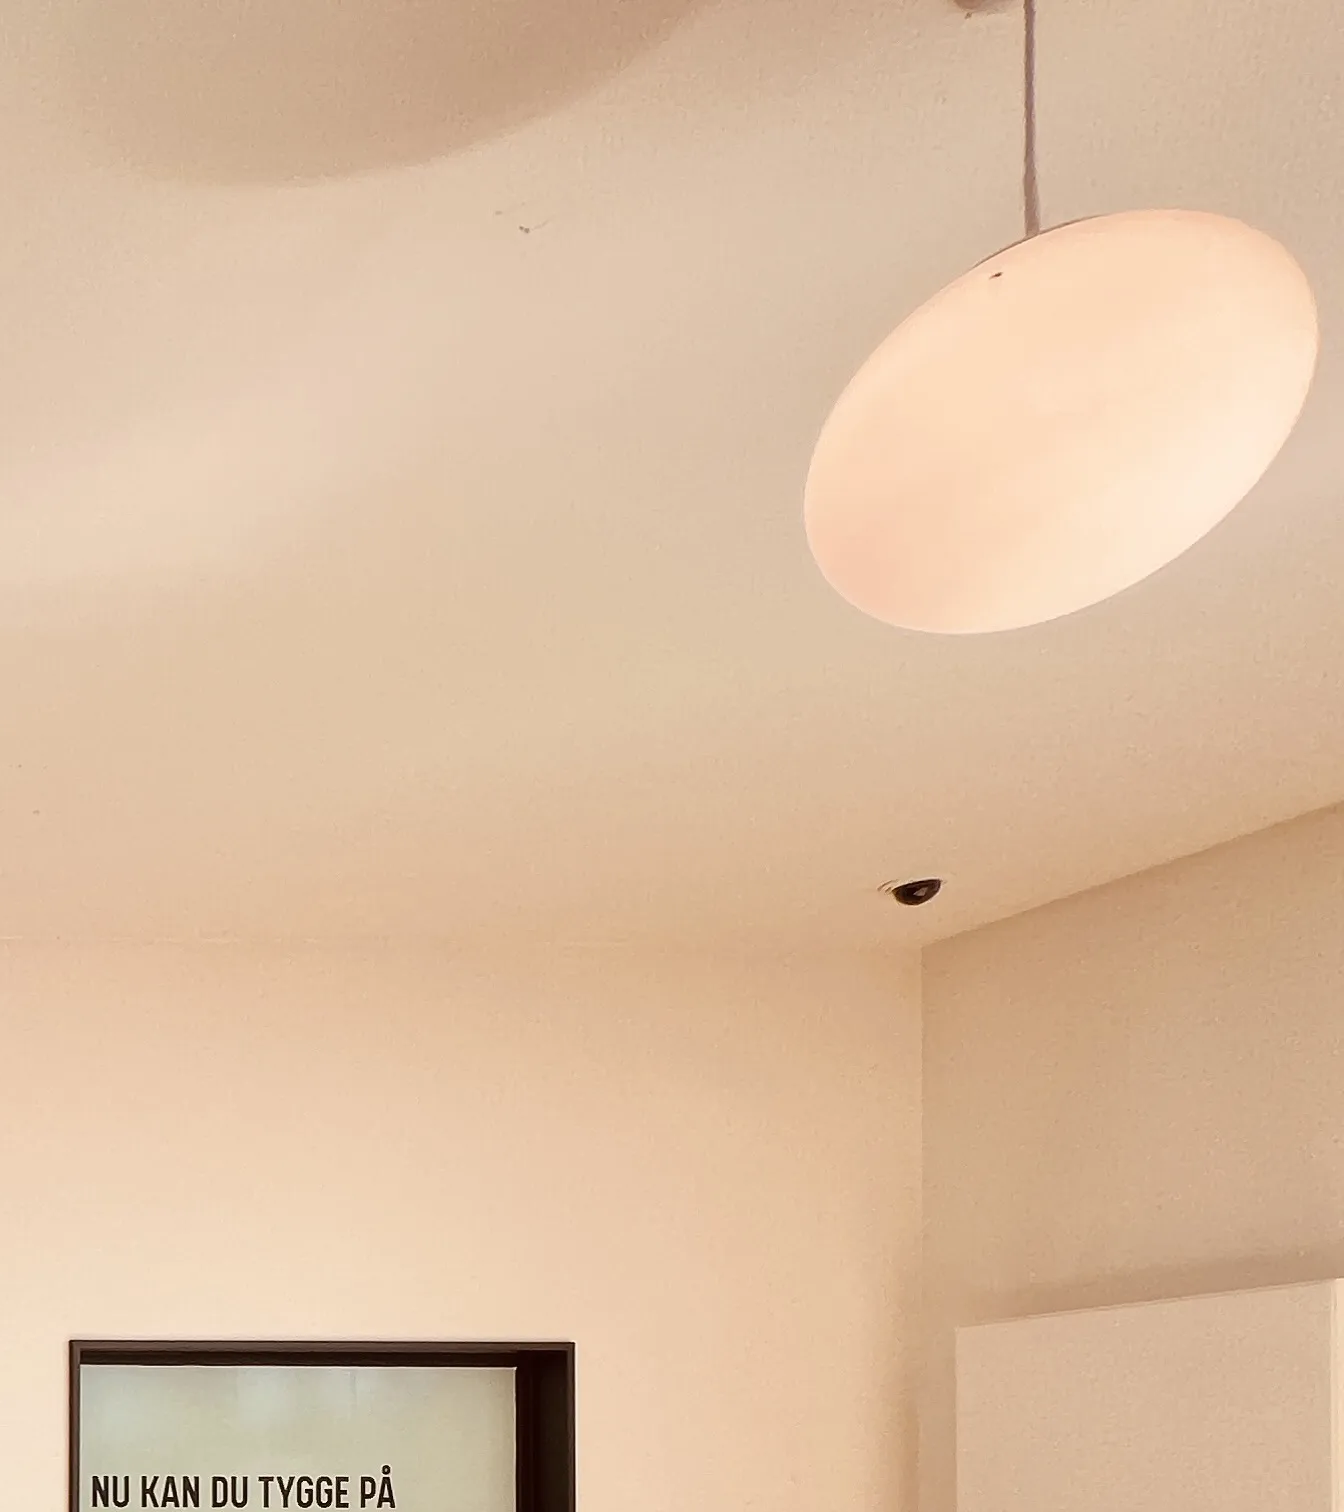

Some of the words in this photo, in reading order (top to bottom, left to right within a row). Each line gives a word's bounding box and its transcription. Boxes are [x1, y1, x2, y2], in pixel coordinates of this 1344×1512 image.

[90, 1475, 131, 1509] NU
[141, 1475, 200, 1509] KAN
[212, 1475, 248, 1509] DU
[258, 1475, 350, 1510] TYGGE
[359, 1465, 396, 1510] PÅ
